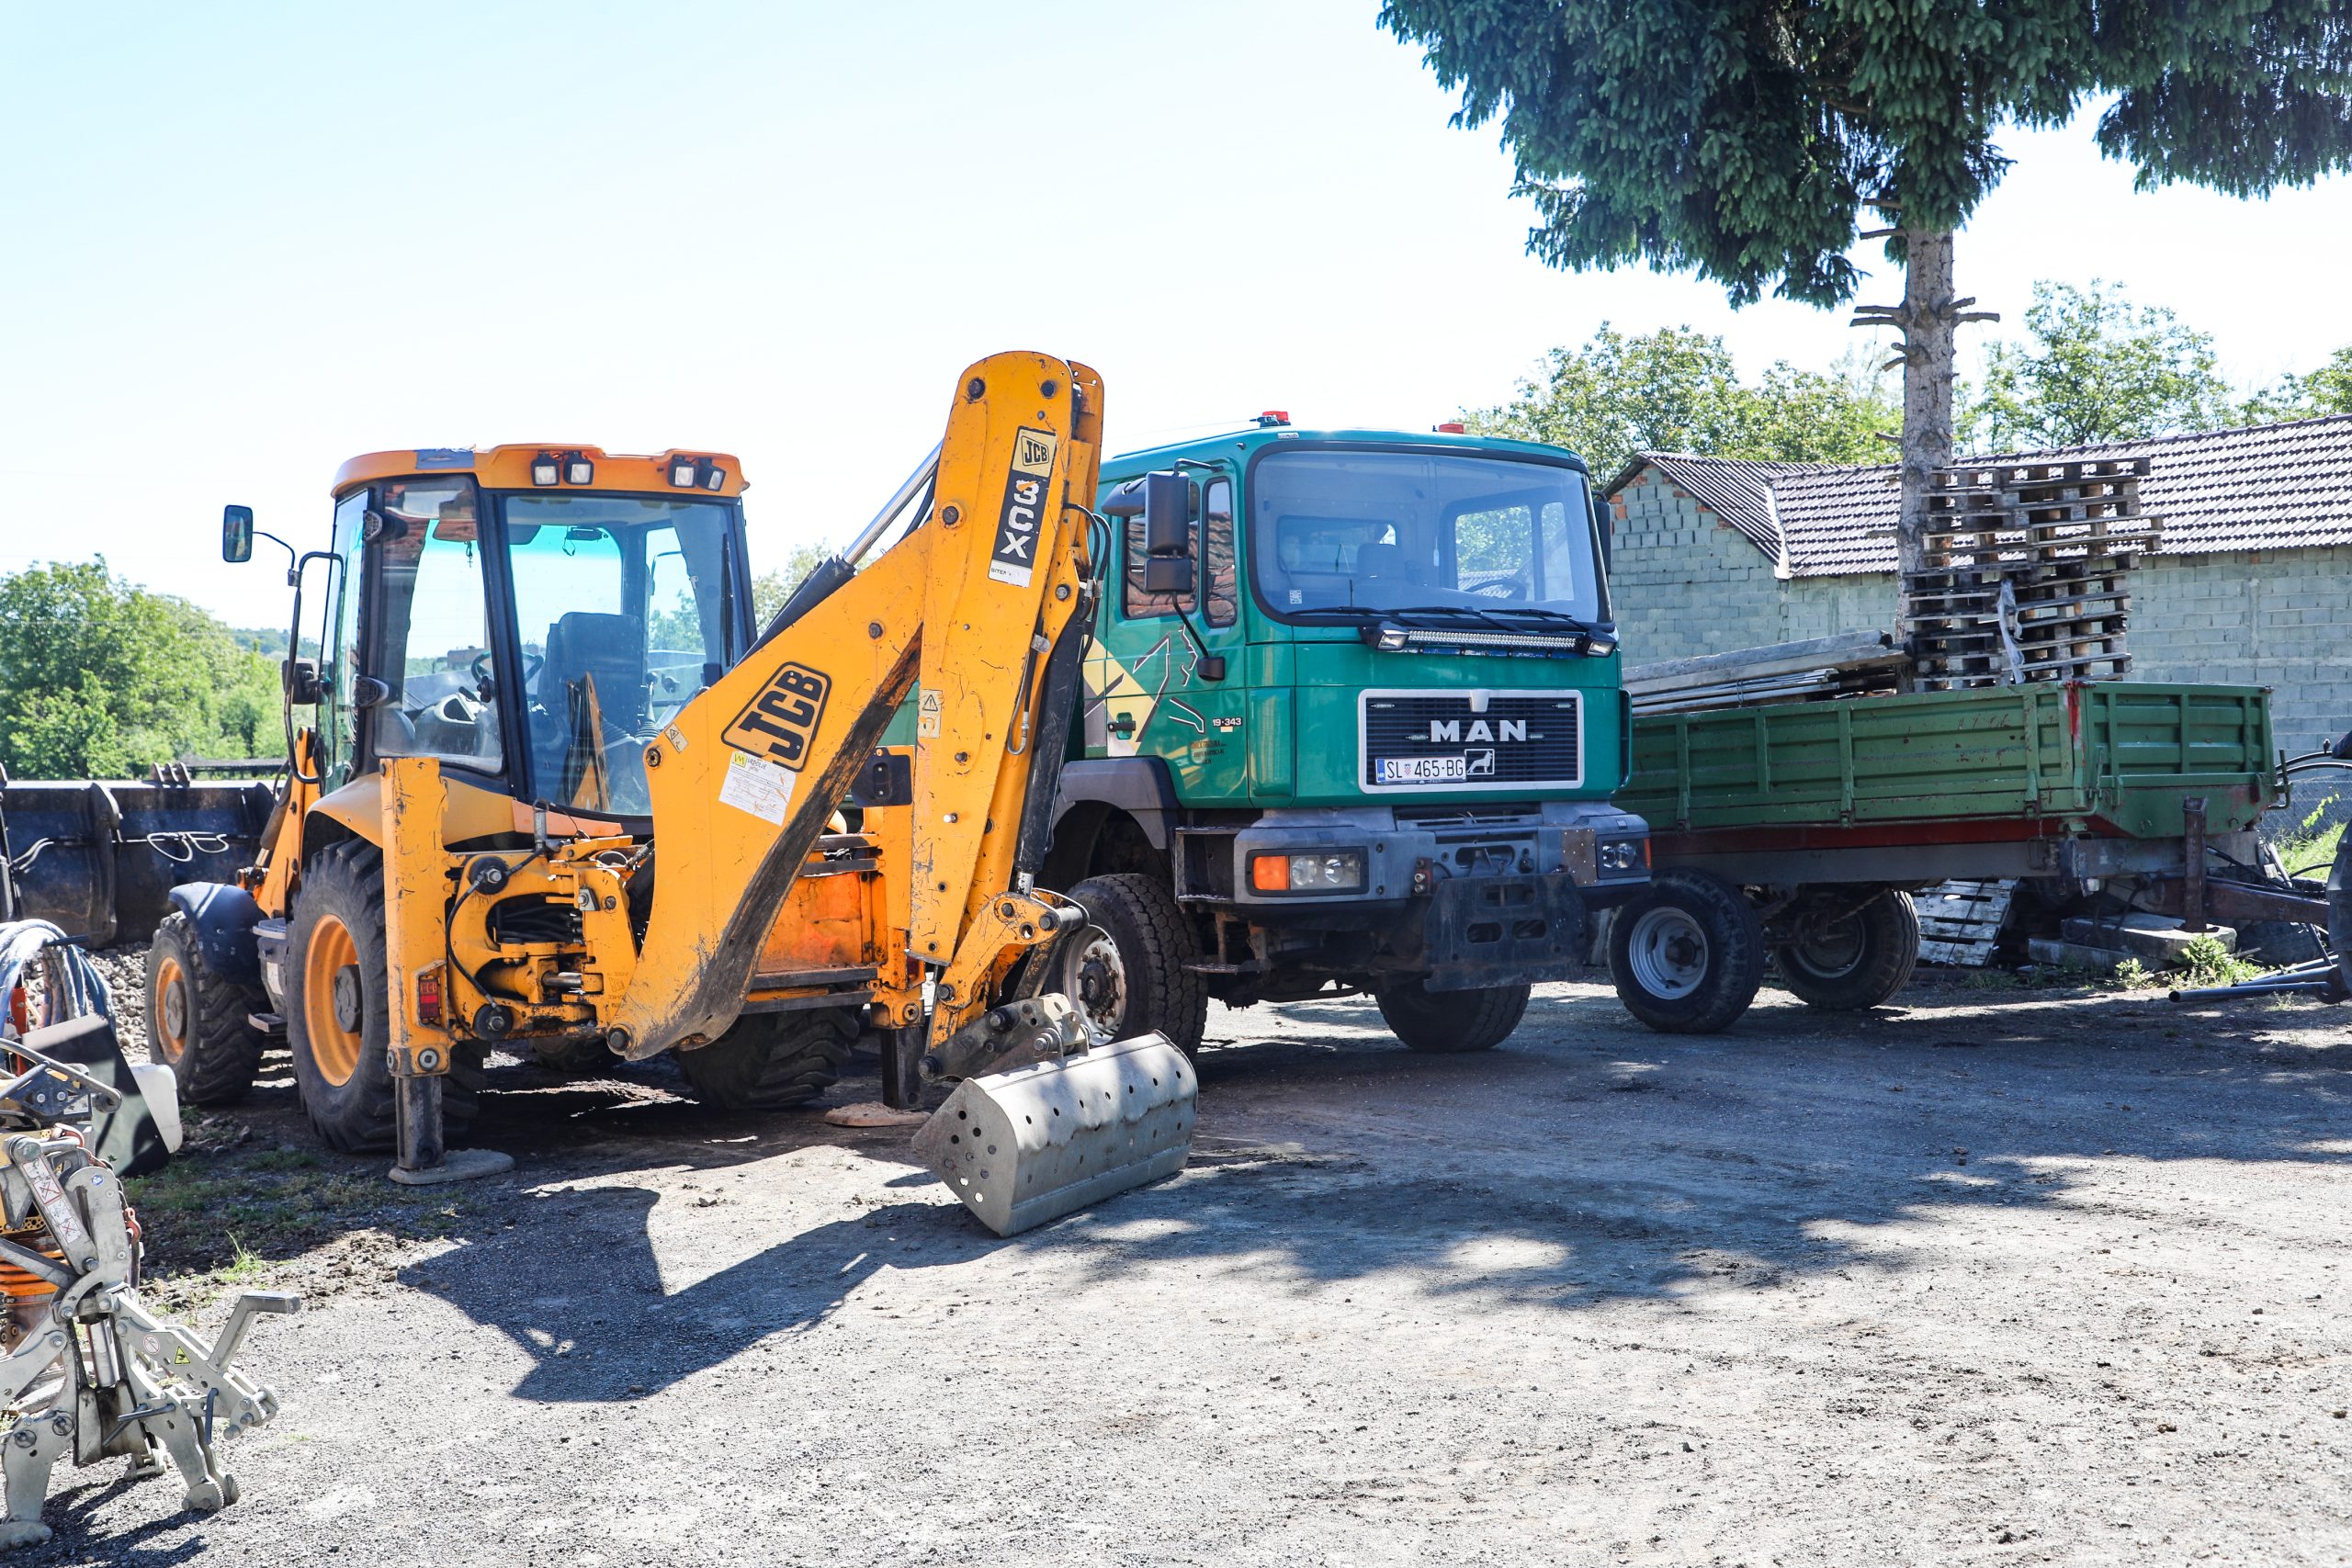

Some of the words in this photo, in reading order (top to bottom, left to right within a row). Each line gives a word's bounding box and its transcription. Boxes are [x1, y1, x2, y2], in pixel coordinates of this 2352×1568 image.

[1024, 439, 1047, 463] JCB
[1000, 479, 1039, 558] 3CX
[738, 670, 822, 761] JCB
[1430, 720, 1526, 742] MAN
[1386, 761, 1402, 778] SL
